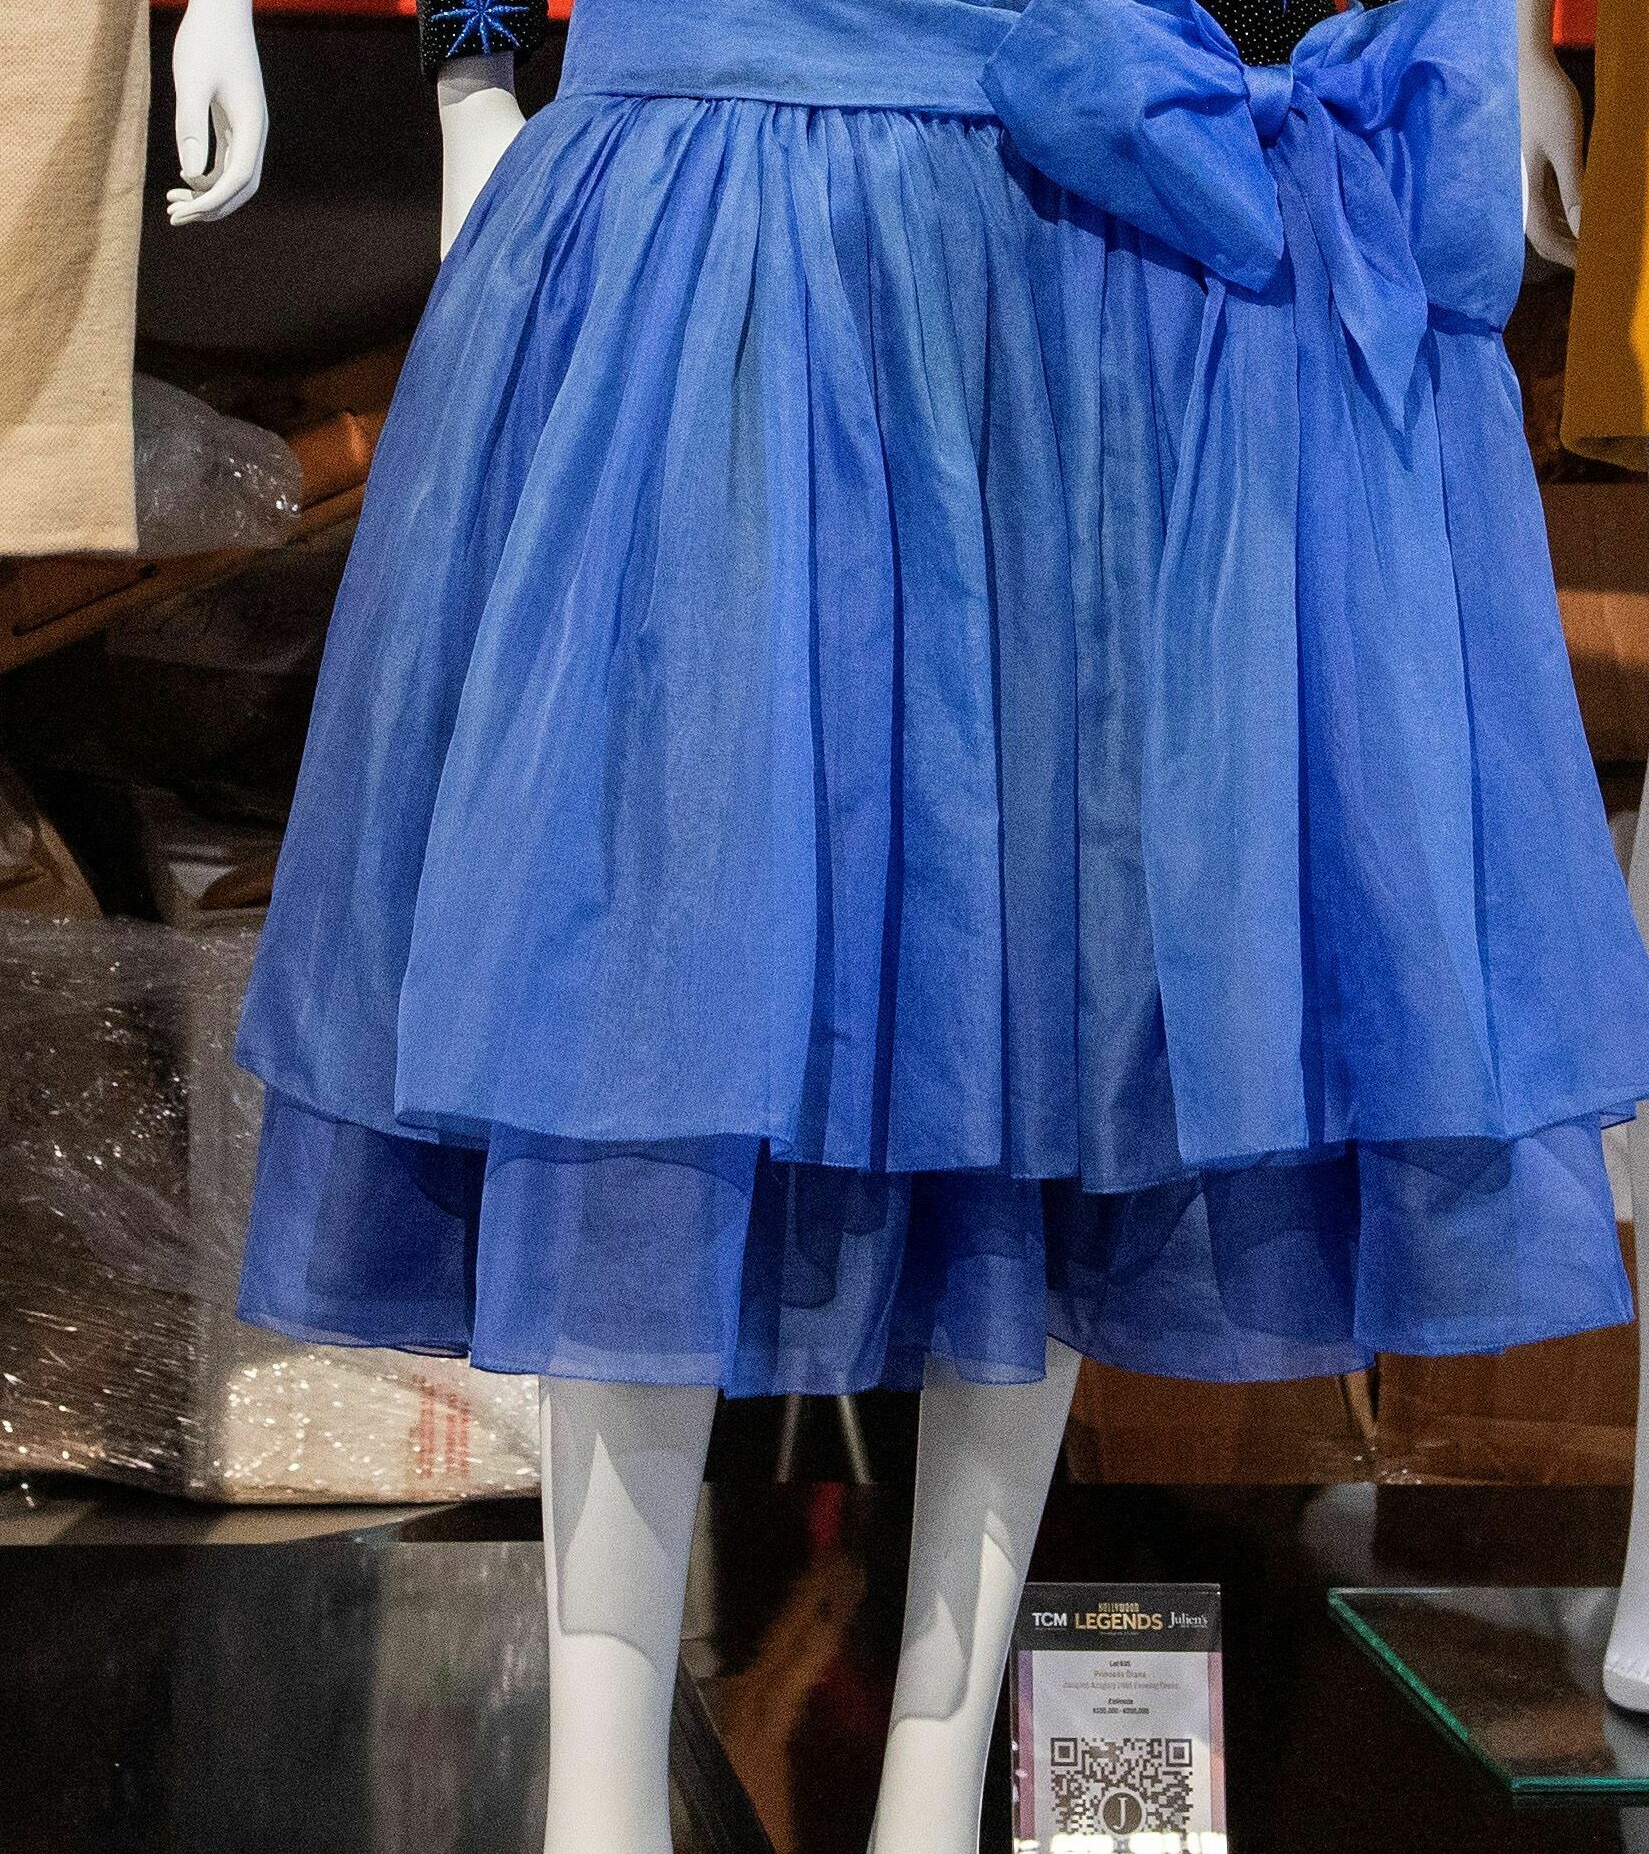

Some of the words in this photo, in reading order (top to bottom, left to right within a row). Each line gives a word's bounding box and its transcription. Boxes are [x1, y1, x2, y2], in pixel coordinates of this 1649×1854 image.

[1098, 1602, 1140, 1613] HOLLYWOOD
[1032, 1612, 1068, 1627] TCM
[1074, 1612, 1164, 1630] LEGENDS
[1167, 1611, 1208, 1628] Julien's
[1112, 1797, 1127, 1831] J
